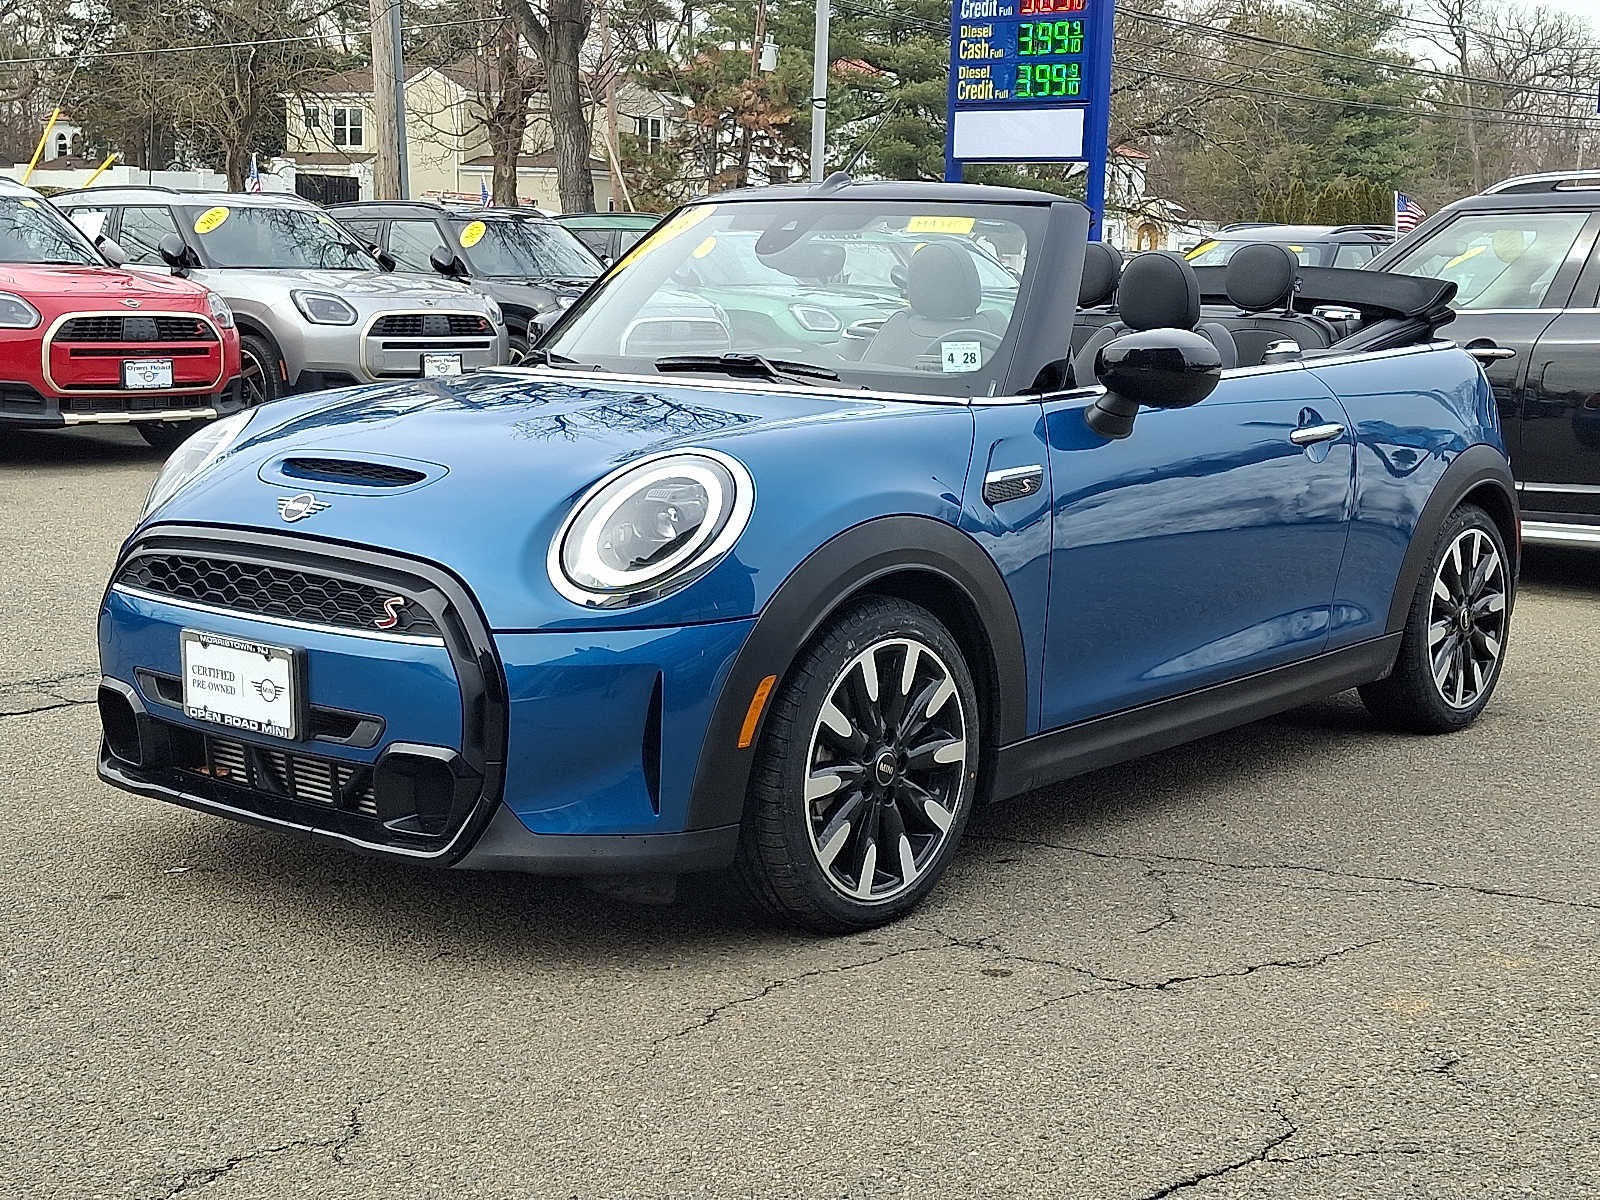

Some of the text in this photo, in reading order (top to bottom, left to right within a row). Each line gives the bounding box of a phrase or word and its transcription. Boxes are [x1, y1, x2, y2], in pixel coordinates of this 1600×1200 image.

[961, 0, 1013, 18] Credit Full
[960, 24, 992, 38] Diesel
[960, 39, 1004, 59] Cash Full
[958, 66, 990, 79] Diesel
[957, 80, 1009, 100] Credit Full
[947, 352, 977, 364] 4 28
[1020, 478, 1032, 493] S
[374, 596, 405, 629] S
[191, 664, 236, 682] CERTIFIED
[189, 707, 288, 738] OPEN ROAD MINI
